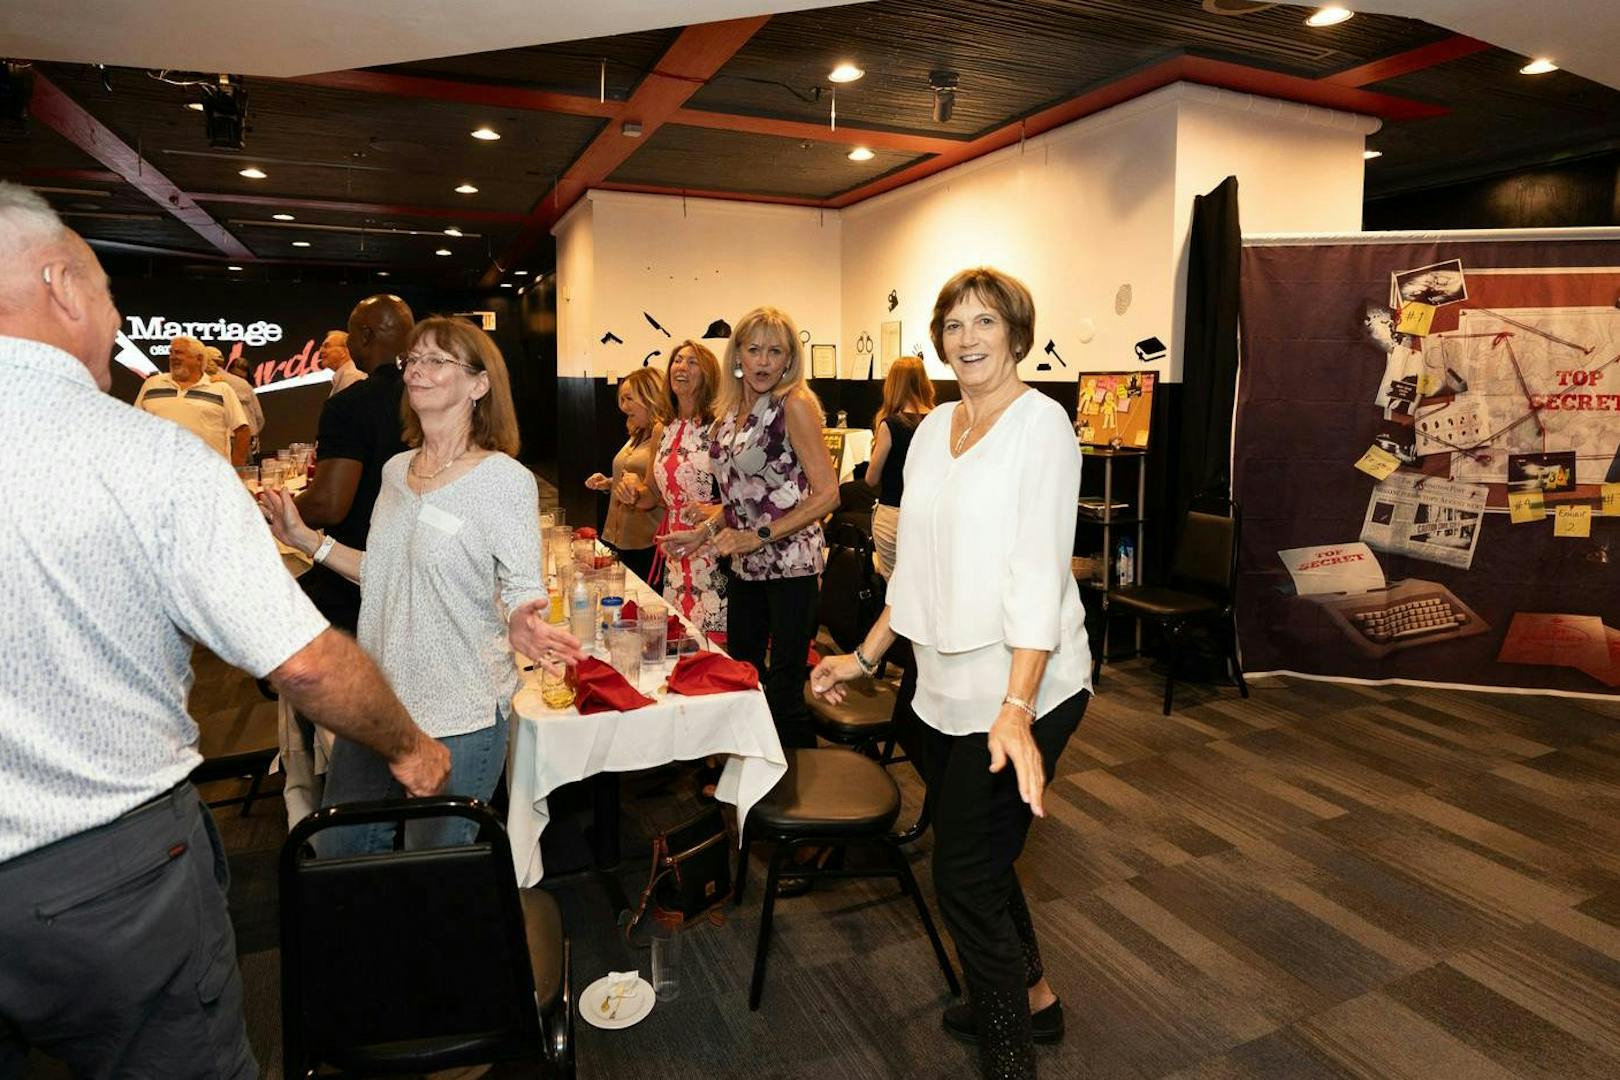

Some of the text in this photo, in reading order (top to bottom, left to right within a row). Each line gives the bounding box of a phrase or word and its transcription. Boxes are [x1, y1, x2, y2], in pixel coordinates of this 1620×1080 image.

[126, 316, 283, 347] Marriage
[1556, 370, 1604, 386] TOP
[1566, 521, 1576, 533] 2
[1297, 553, 1365, 572] SECRET
